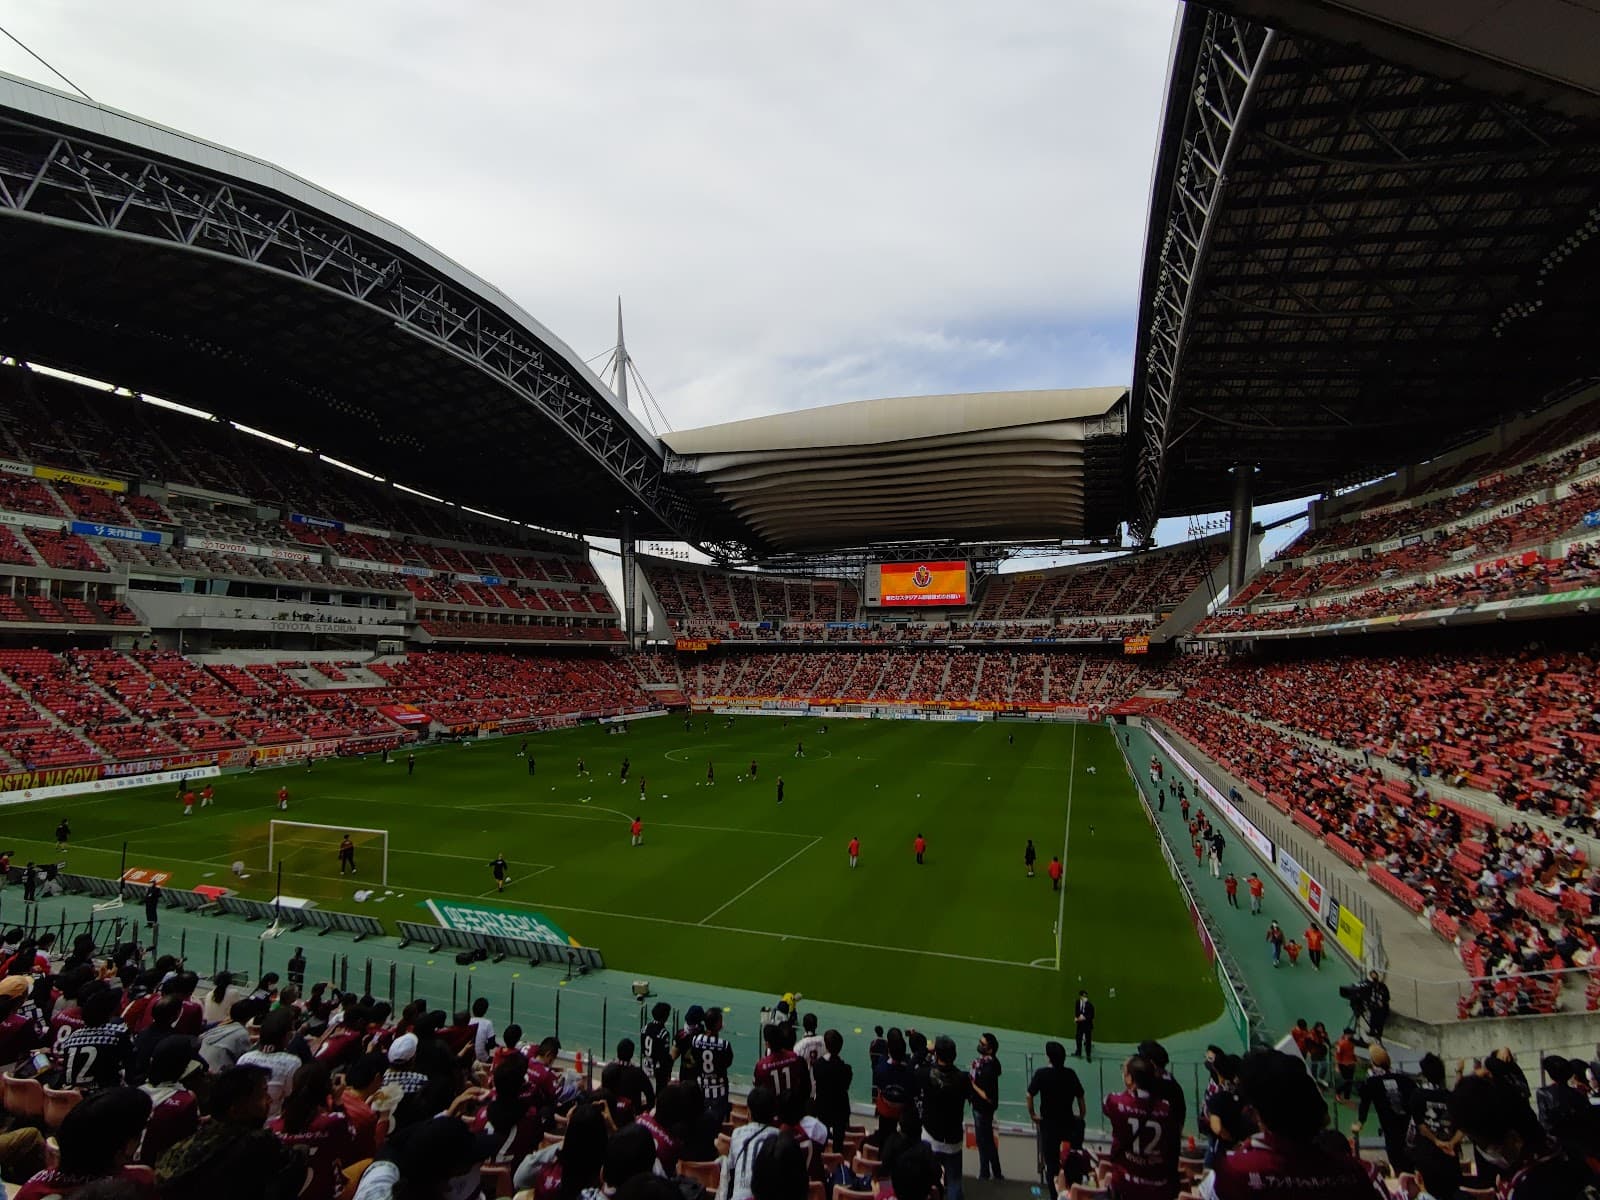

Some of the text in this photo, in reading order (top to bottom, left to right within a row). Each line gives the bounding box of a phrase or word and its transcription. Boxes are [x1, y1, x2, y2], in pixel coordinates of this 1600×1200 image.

[62, 474, 110, 486] DUNLOP
[1501, 498, 1536, 517] HINO
[215, 542, 247, 553] TOYOTA
[283, 552, 311, 562] TOYOTA
[271, 621, 357, 634] TOYOTA STADIUM
[45, 766, 99, 788] NAGOYA
[104, 758, 164, 777] MATEUS
[65, 1045, 98, 1085] 12
[702, 1049, 715, 1074] 8
[770, 1066, 792, 1097] 11
[1127, 1117, 1163, 1156] 12
